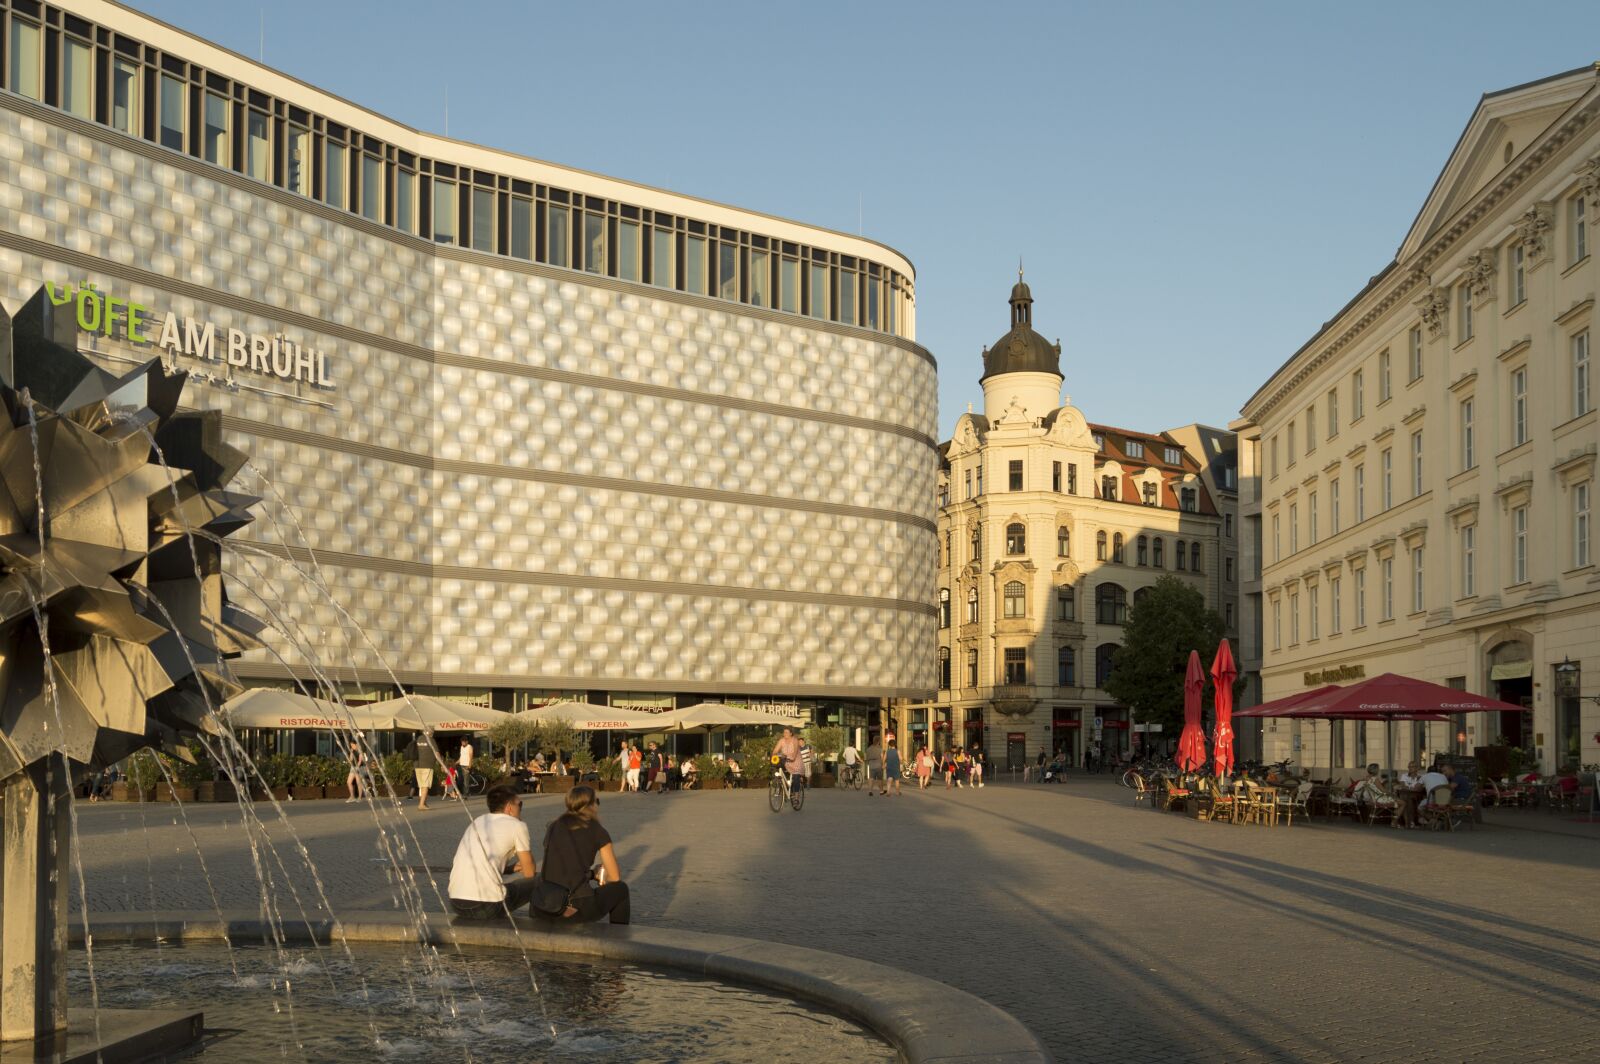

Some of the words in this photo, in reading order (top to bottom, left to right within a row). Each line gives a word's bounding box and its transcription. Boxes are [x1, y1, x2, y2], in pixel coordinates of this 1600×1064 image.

[159, 311, 216, 360] AM
[227, 328, 336, 388] BRÜHL
[768, 702, 801, 717] BRÜHL
[280, 718, 347, 727] RISTORANTE
[439, 721, 489, 729] VALENTINO
